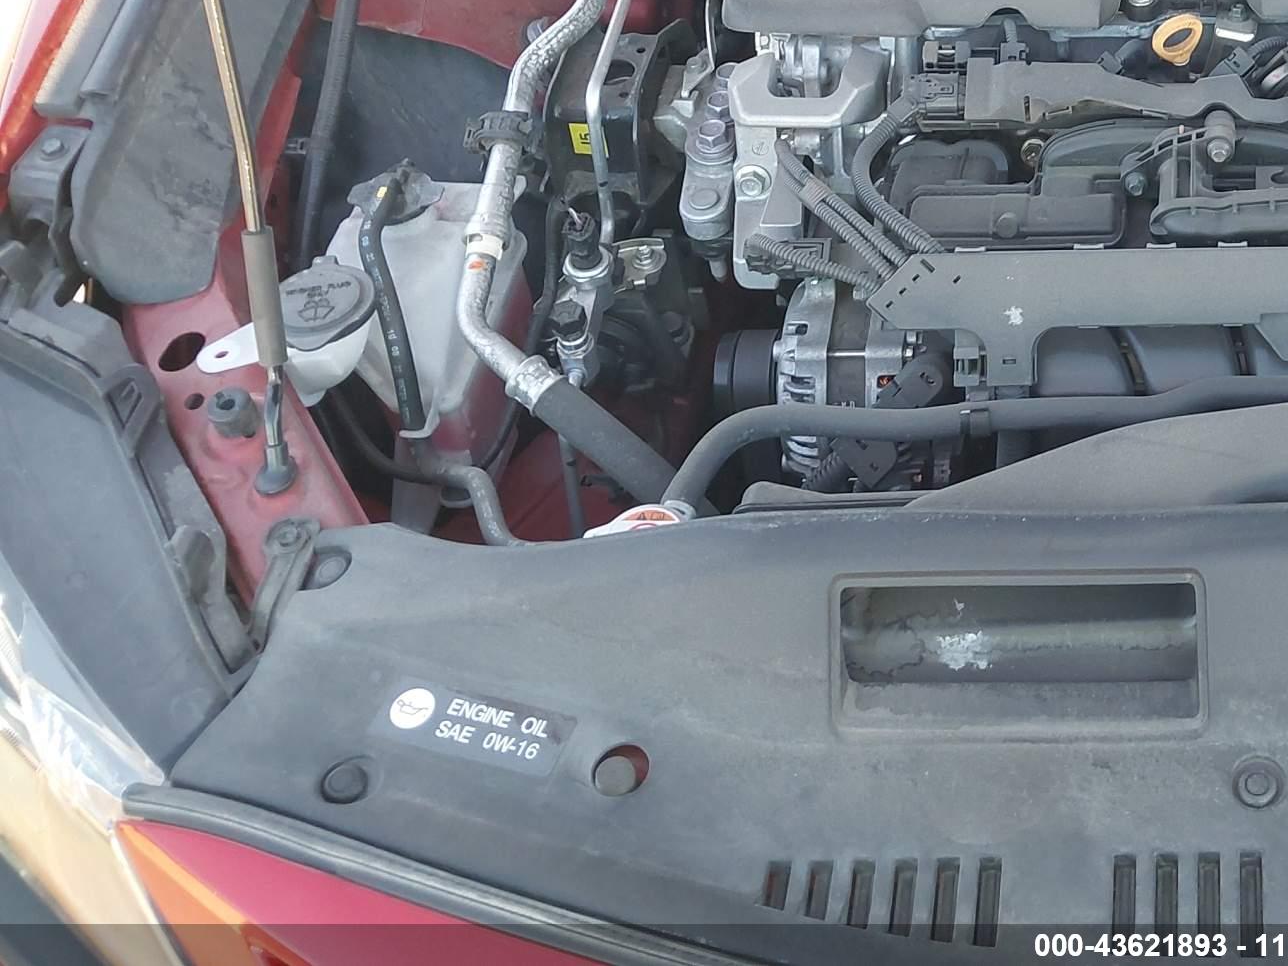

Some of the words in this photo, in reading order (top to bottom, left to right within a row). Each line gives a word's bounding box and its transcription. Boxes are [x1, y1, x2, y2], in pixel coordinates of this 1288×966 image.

[446, 698, 515, 729] ENGINE
[520, 716, 549, 738] OIL
[434, 720, 477, 744] SAE
[482, 732, 540, 760] 0W-16
